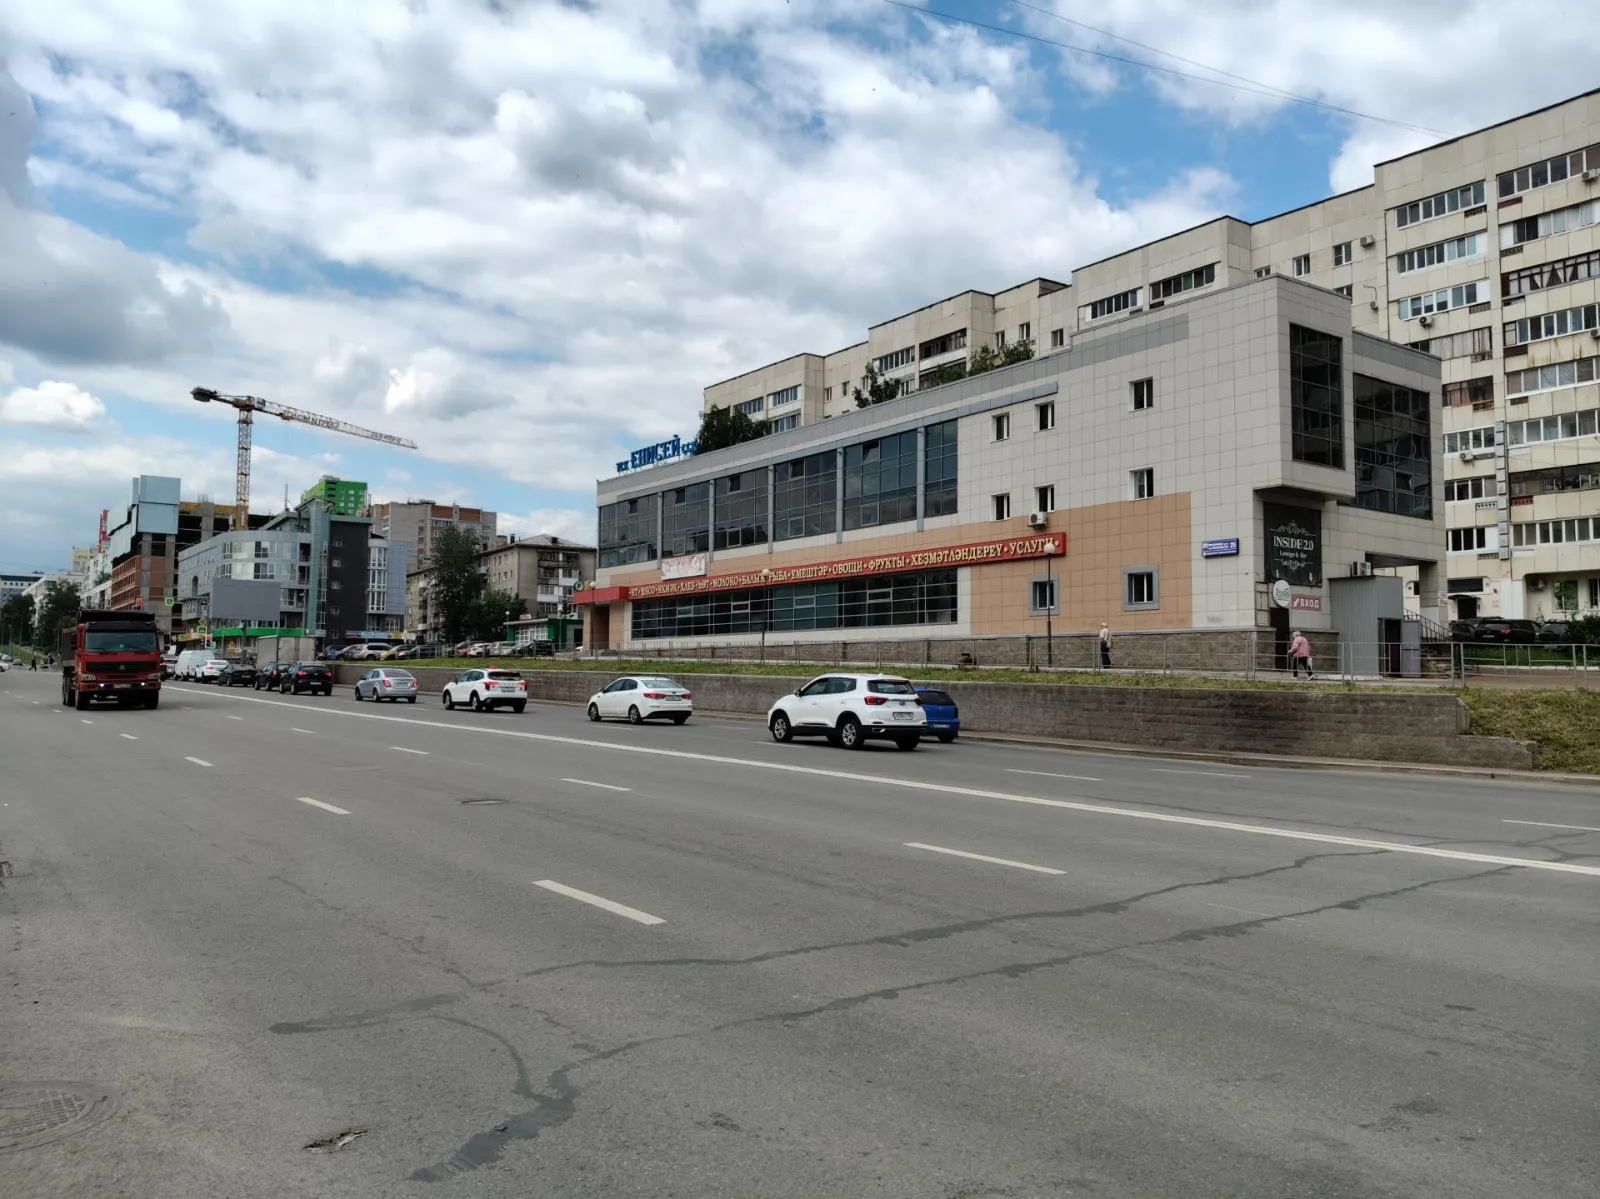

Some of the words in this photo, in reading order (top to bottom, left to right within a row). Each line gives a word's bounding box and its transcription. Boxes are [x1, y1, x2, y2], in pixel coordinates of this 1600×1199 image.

[630, 434, 681, 469] ЕНИСЕЙ
[1273, 536, 1303, 549] INSIDE
[1303, 540, 1314, 551] 2.0
[640, 586, 656, 596] МЯСО
[680, 581, 695, 592] ХЛЕБ
[712, 576, 739, 588] МОЛОКО
[768, 571, 788, 583] РЫБА
[832, 561, 863, 575] ОВОЩИ
[868, 556, 905, 572] ФРУКТЫ
[1300, 598, 1320, 609] ВХОД
